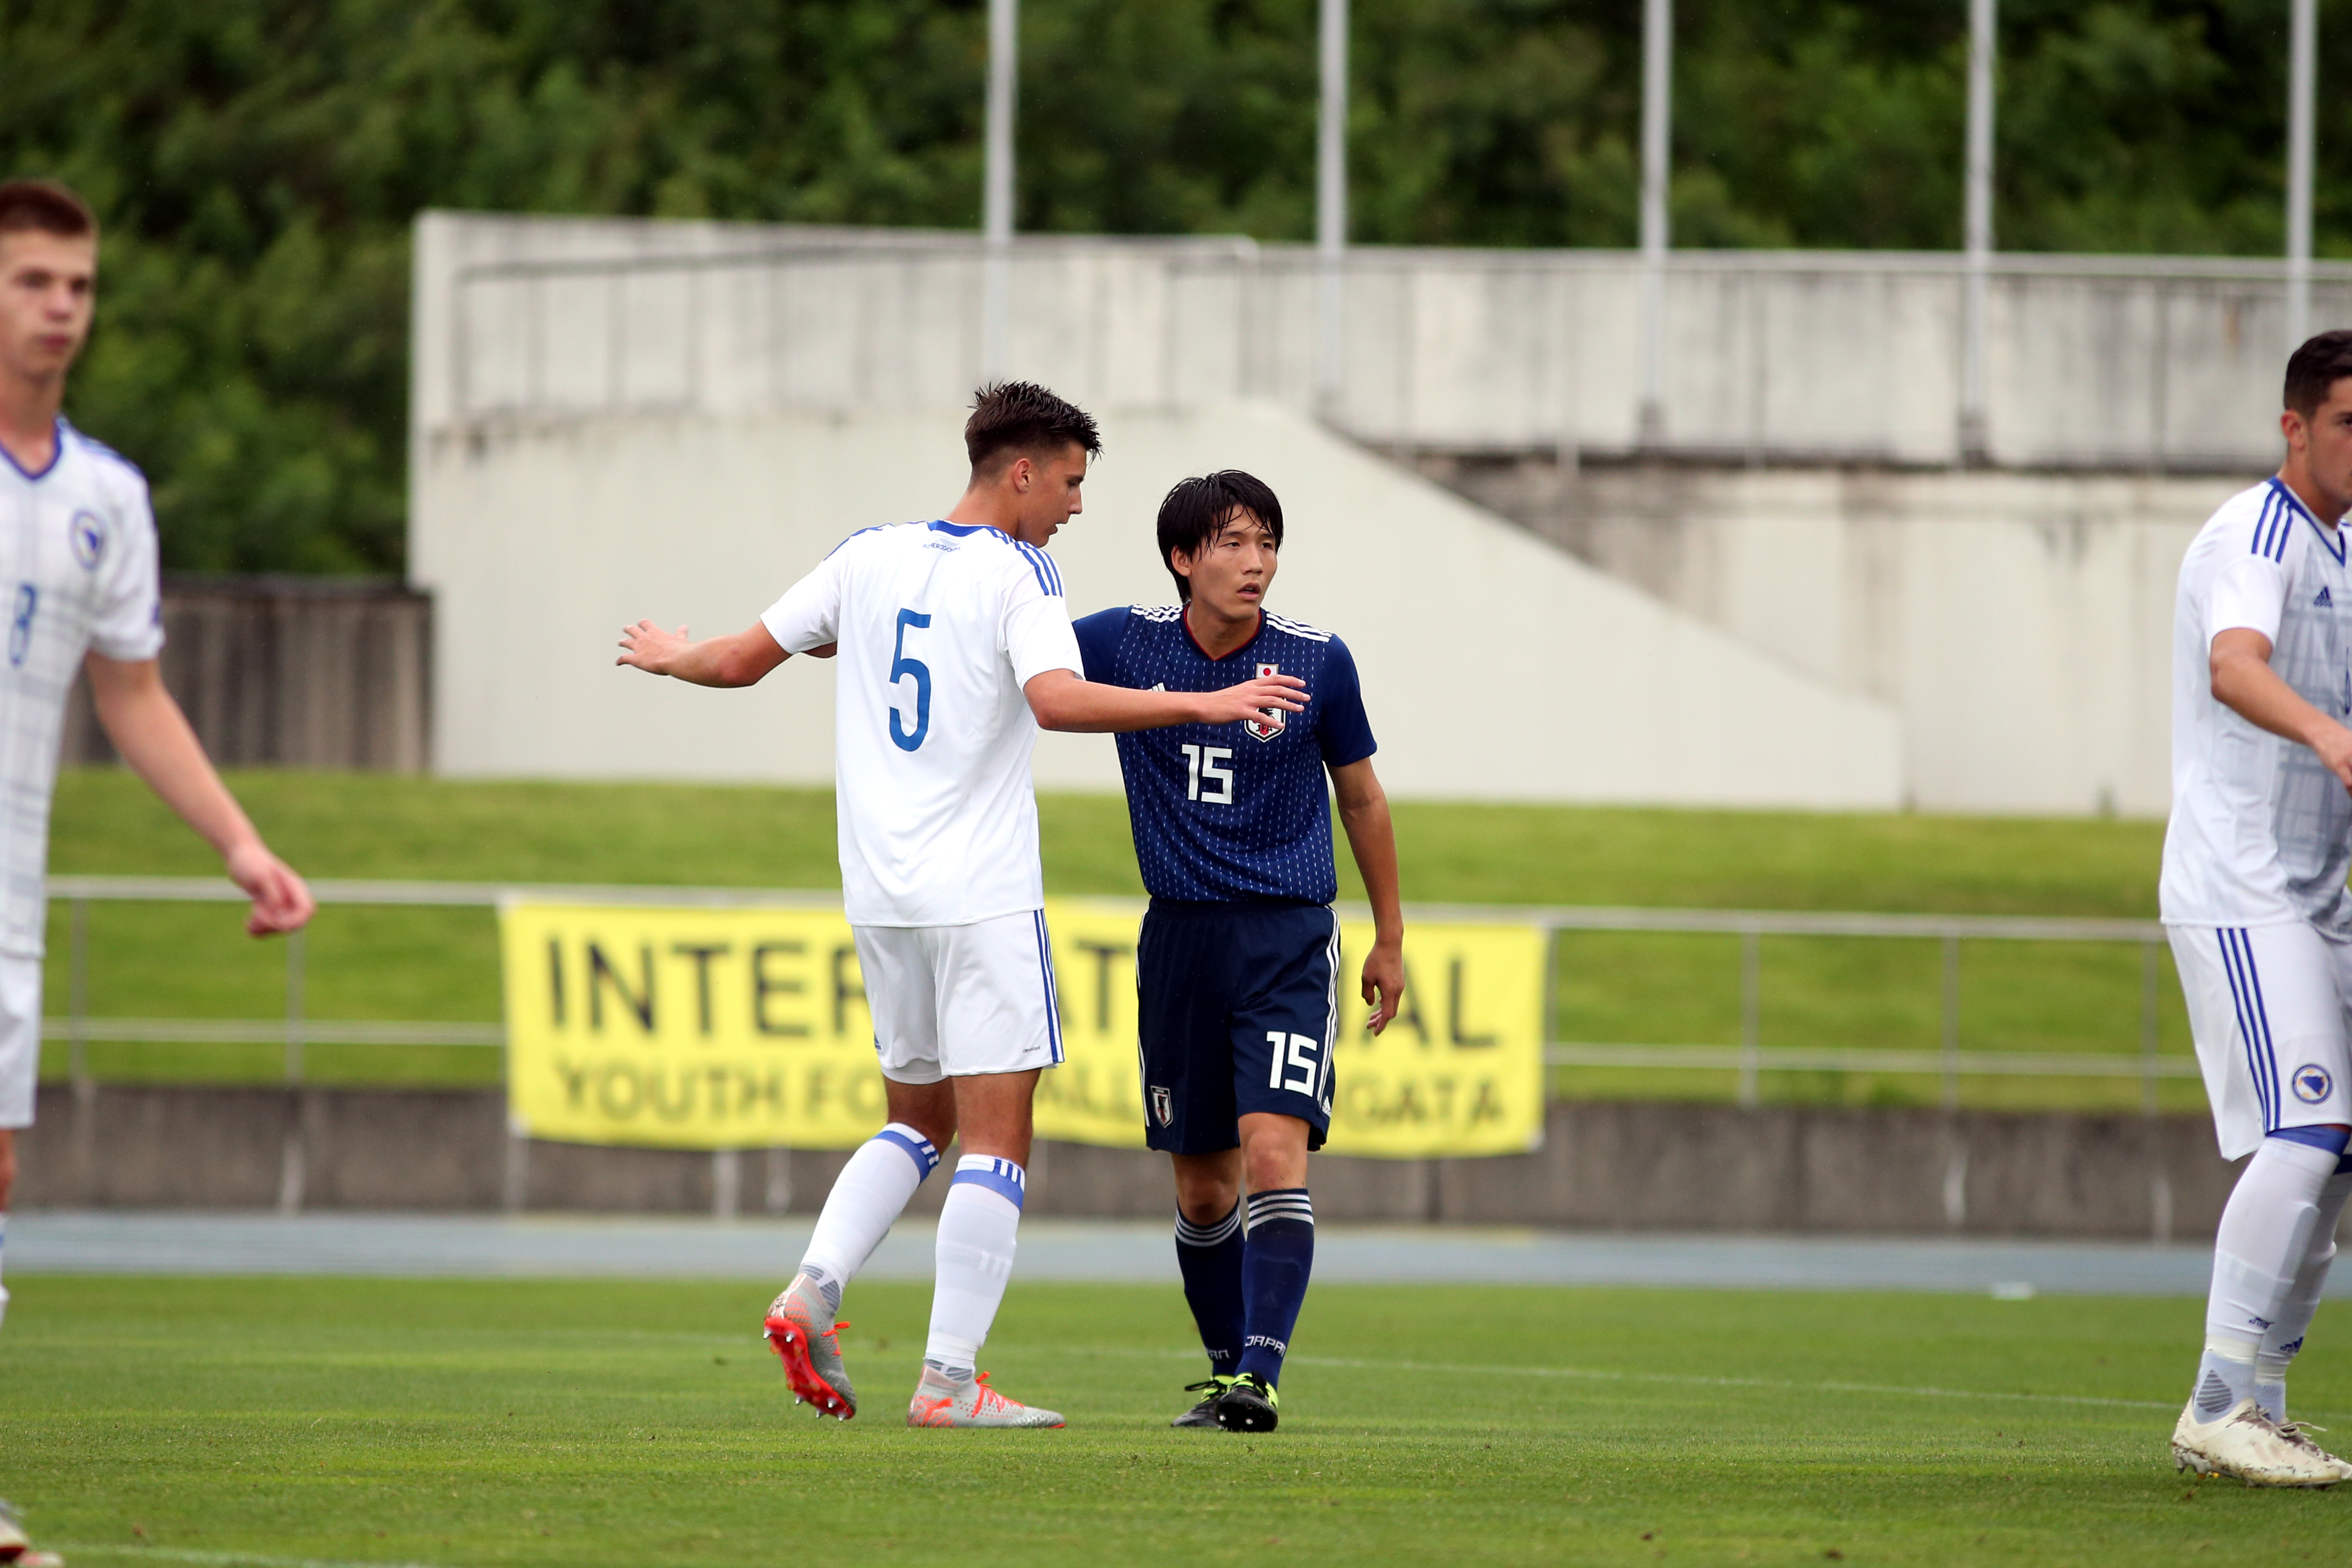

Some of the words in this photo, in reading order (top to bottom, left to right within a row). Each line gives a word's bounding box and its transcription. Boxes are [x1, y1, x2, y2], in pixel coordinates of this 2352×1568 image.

[889, 608, 931, 752] 5
[1182, 744, 1233, 804] 15
[548, 940, 1495, 1046] INTETAL
[555, 1061, 788, 1121] YOUTH
[806, 1063, 1141, 1121] FOALL
[1267, 1031, 1317, 1097] 15
[1245, 1335, 1286, 1357] JAPAN
